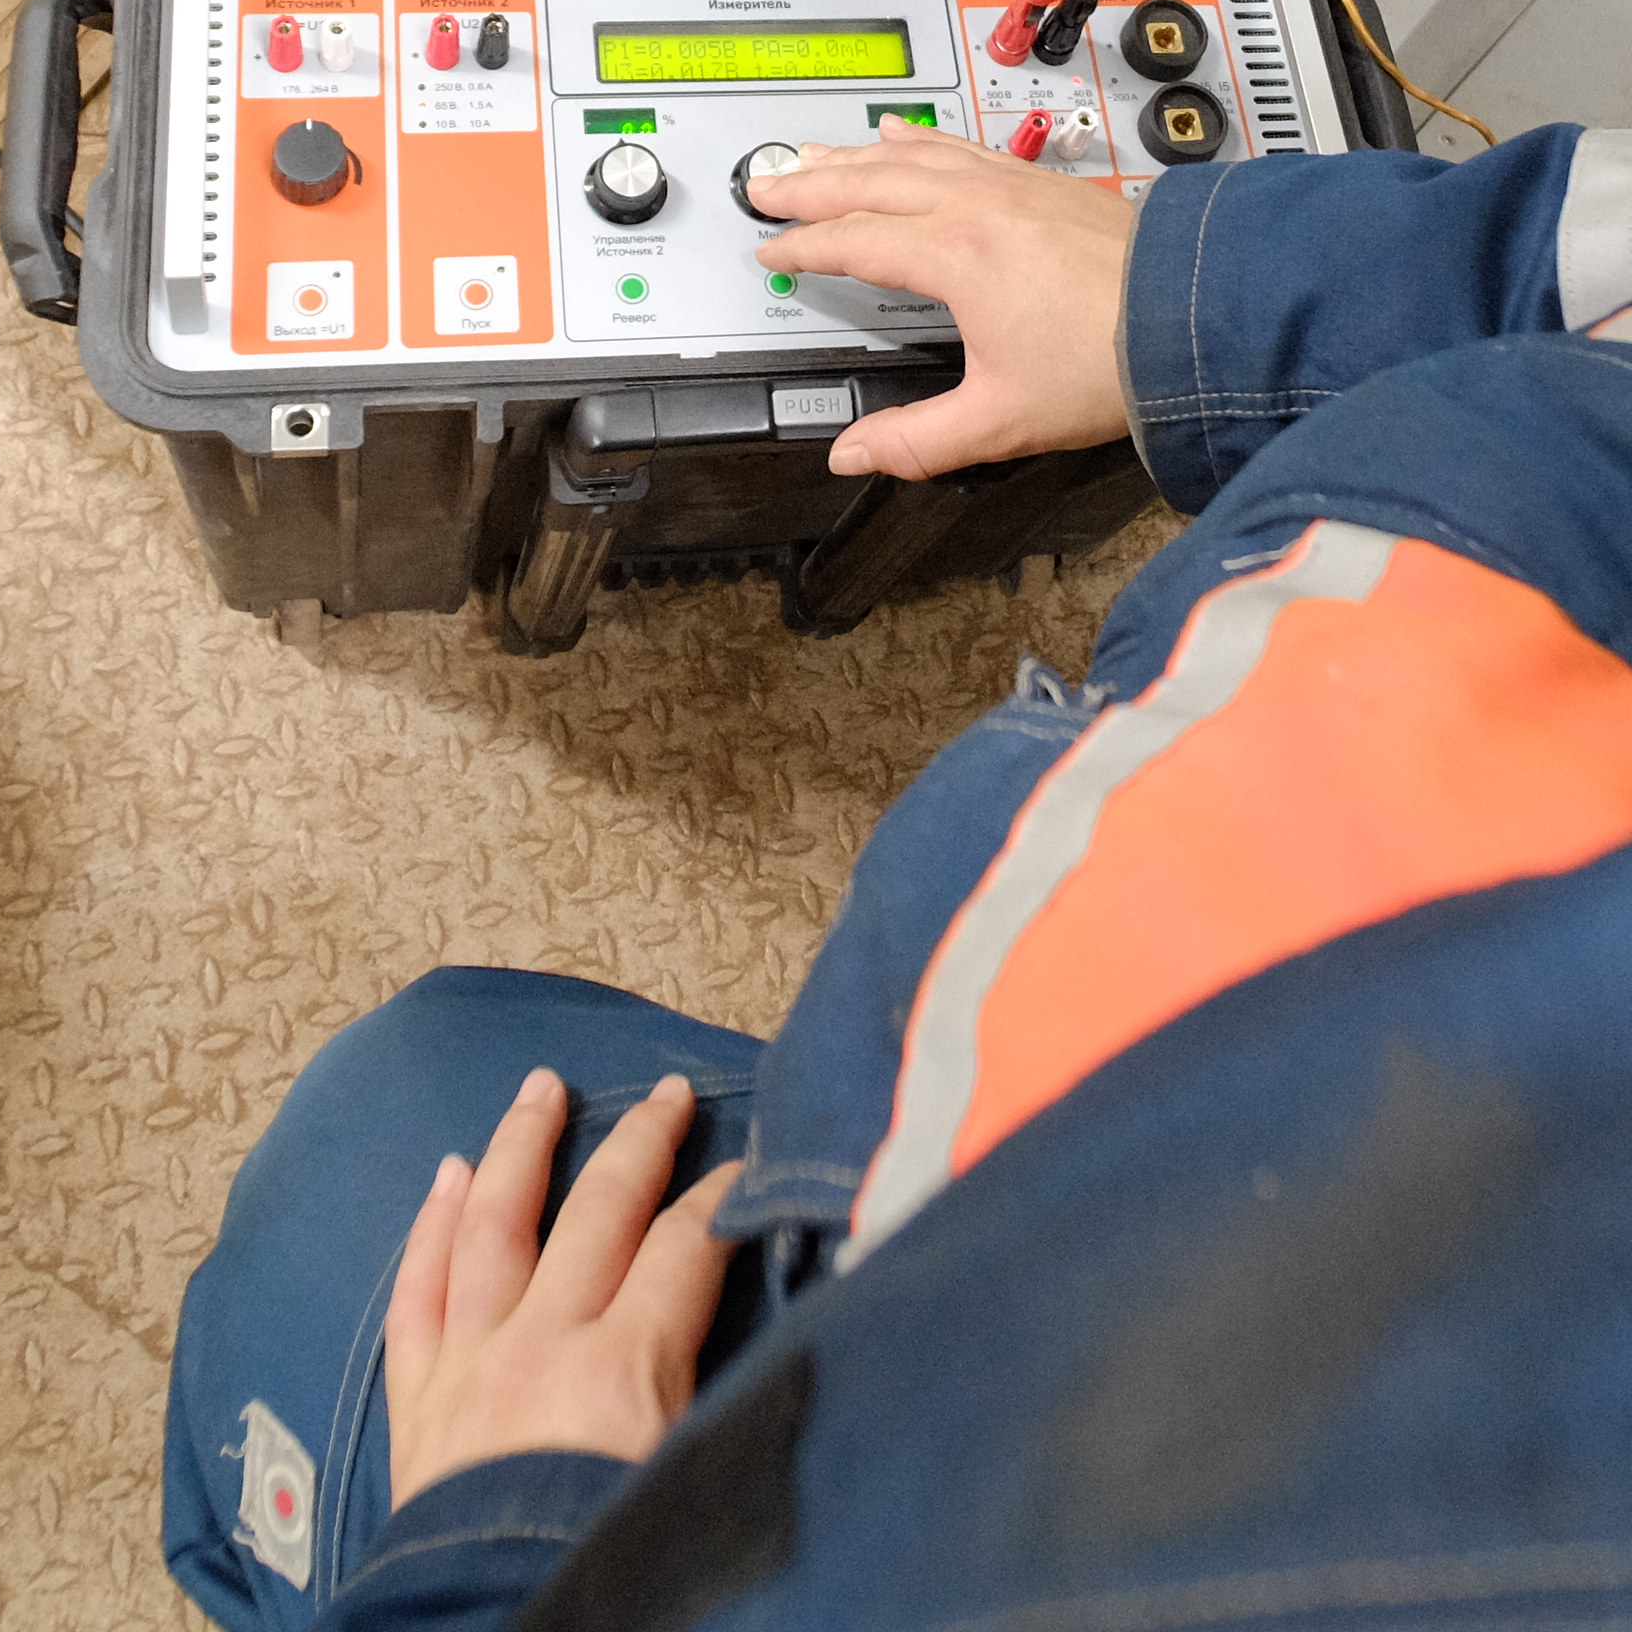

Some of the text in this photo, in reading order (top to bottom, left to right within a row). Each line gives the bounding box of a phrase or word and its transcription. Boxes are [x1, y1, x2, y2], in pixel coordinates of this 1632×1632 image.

[708, 0, 791, 11] Измеритель
[461, 19, 479, 29] U2
[434, 82, 453, 92] 250
[986, 91, 1003, 99] 500
[1029, 90, 1045, 98] 250
[436, 120, 448, 128] 10
[470, 120, 482, 128] 10
[592, 234, 666, 246] Управление
[758, 230, 782, 240] Мен
[596, 245, 663, 257] Источник 2
[765, 306, 804, 320] Сброс
[878, 302, 934, 314] Фиксация
[461, 319, 491, 330] Пуск
[612, 313, 657, 325] Реверс
[274, 325, 316, 336] Выход
[784, 396, 842, 414] PUSH
